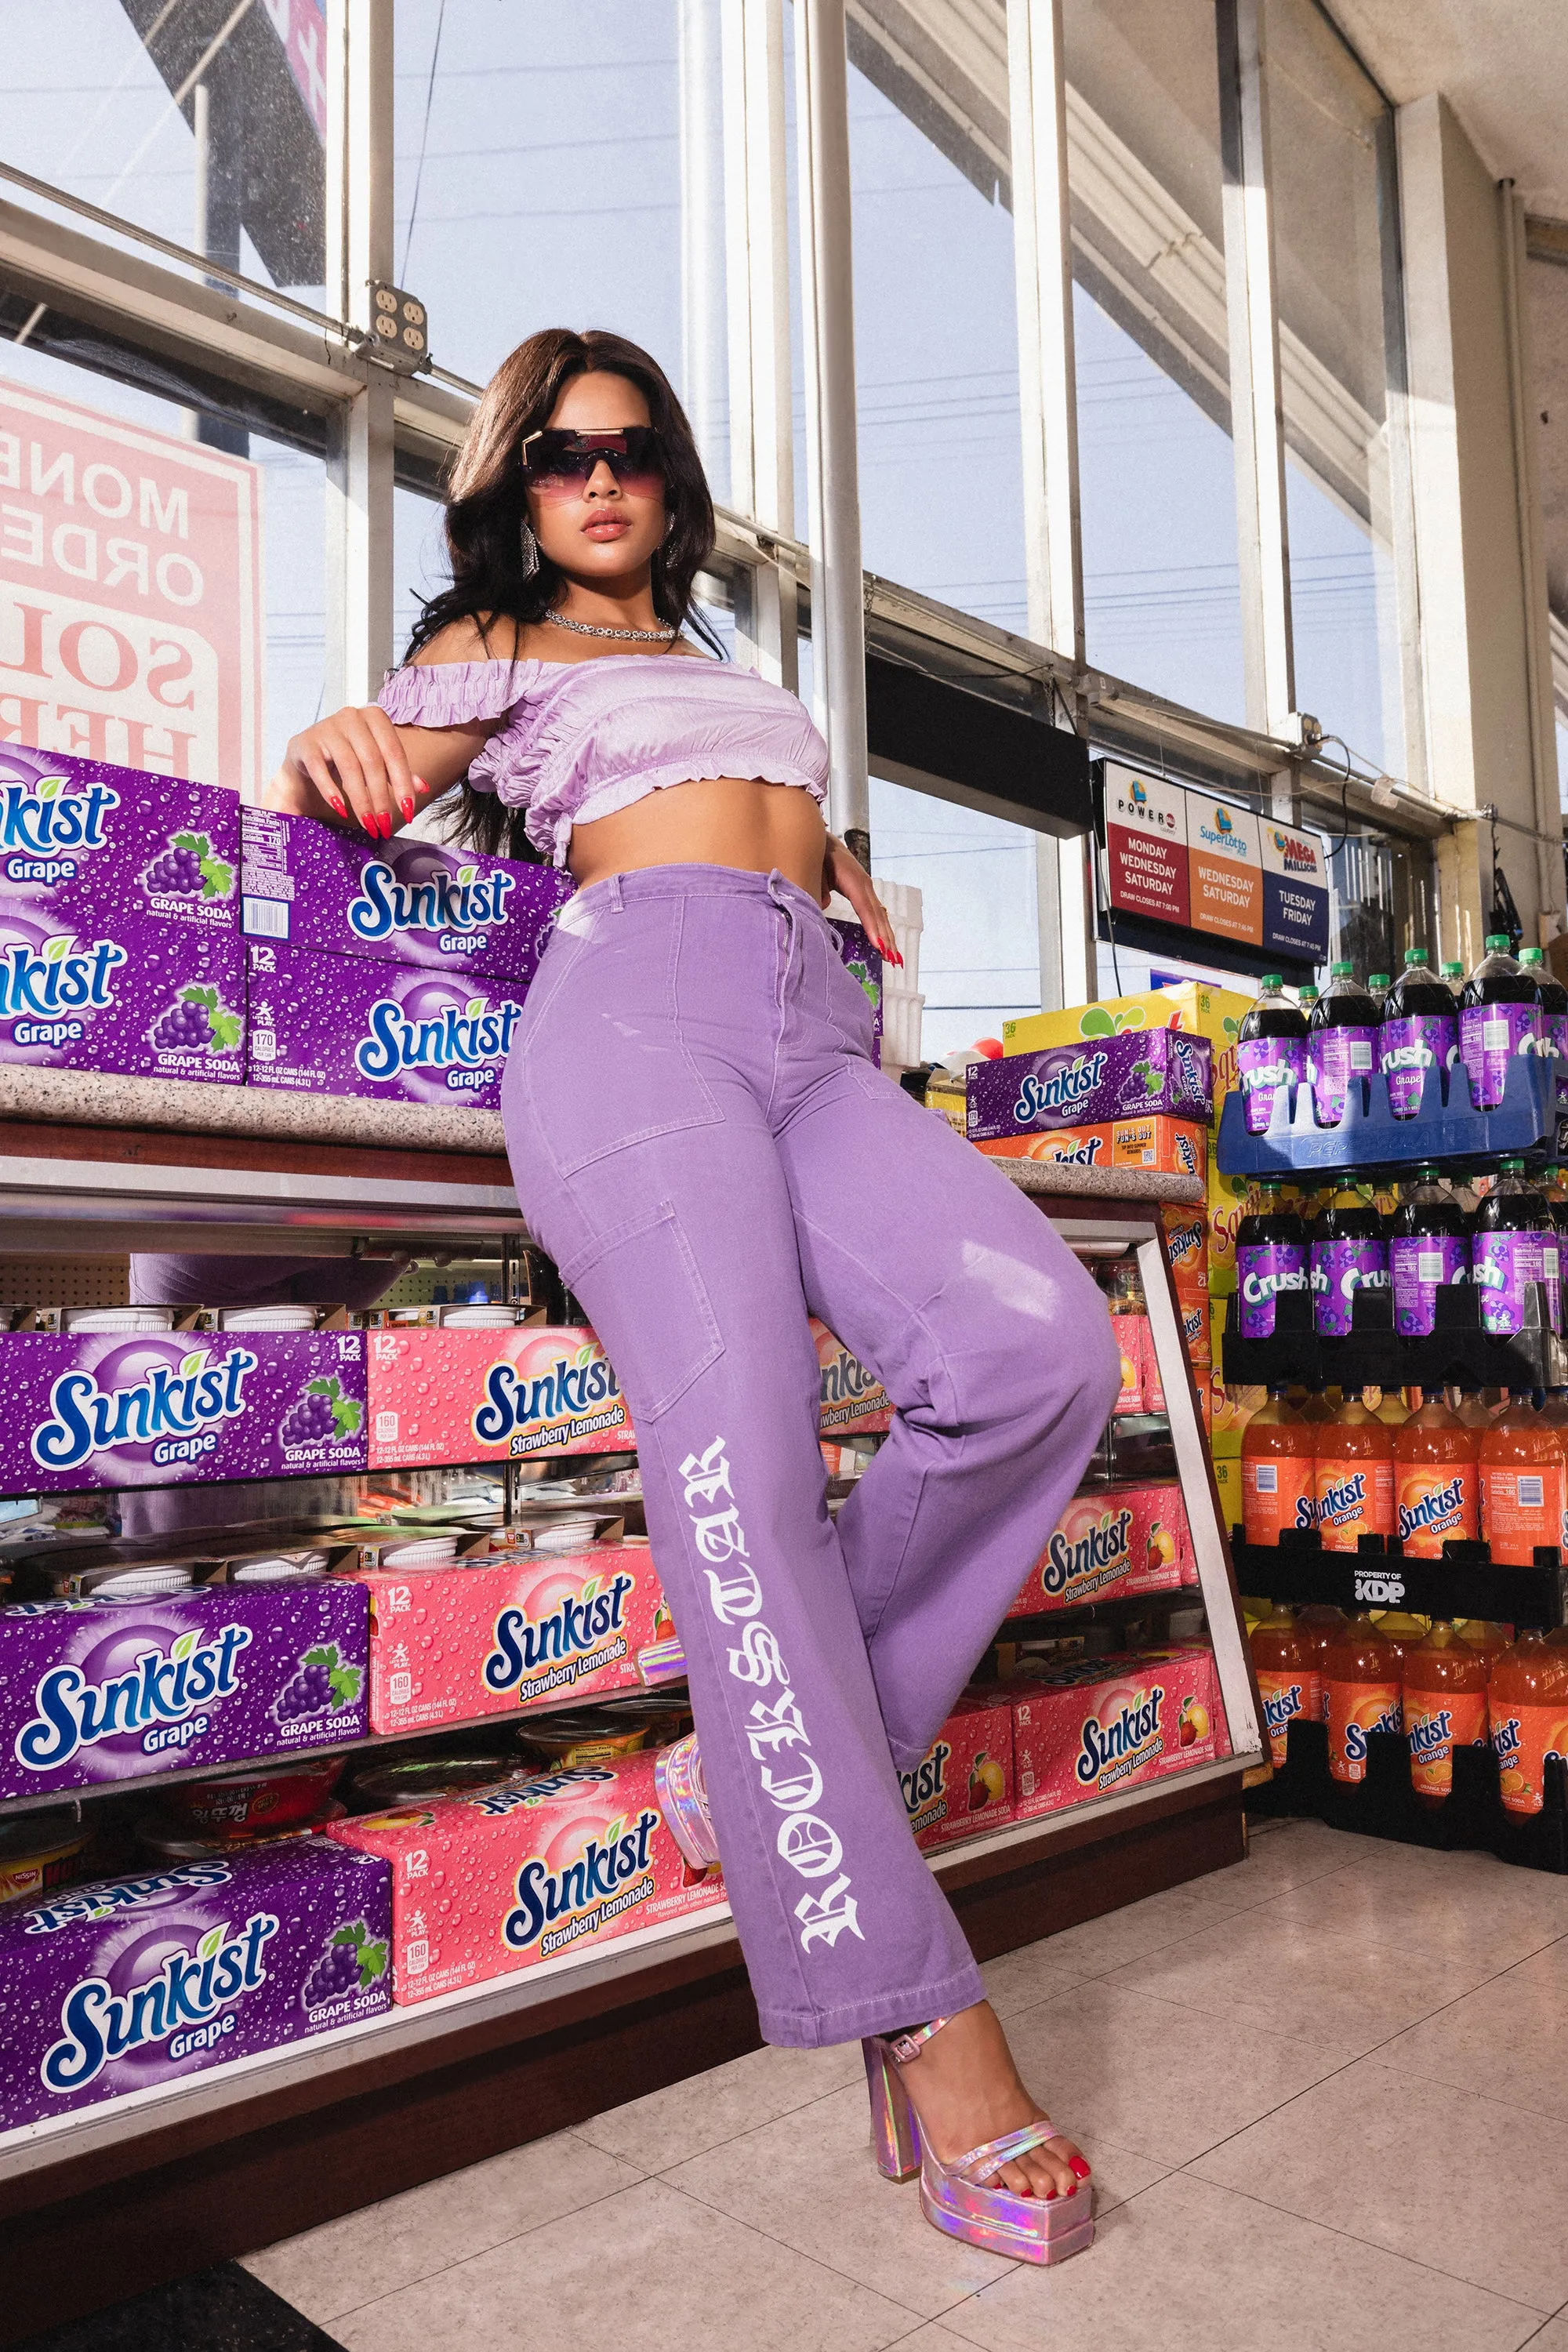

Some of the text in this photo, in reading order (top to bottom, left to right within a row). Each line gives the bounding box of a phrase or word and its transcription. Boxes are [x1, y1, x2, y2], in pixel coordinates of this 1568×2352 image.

[0, 785, 118, 853] kist
[1117, 799, 1165, 824] POWER
[1127, 837, 1167, 860] MONDAY
[1200, 826, 1247, 851] SuperLotto
[1283, 834, 1316, 865] MEGA
[9, 858, 75, 884] Grape
[1120, 851, 1177, 880] WEDNESDAY
[1283, 861, 1318, 873] MILLIONS
[1125, 871, 1174, 895] SATURDAY
[1198, 866, 1254, 893] WEDNESDAY
[350, 863, 513, 938] Sunkist
[1120, 891, 1135, 901] DRAW
[1136, 894, 1156, 907] CLOSES
[1172, 904, 1180, 913] PM
[1203, 884, 1250, 909] SATURDAY
[1279, 889, 1316, 912] TUESDAY
[150, 897, 232, 921] GRAPE SODA
[1283, 907, 1312, 926] FRIDAY
[1200, 913, 1214, 923] DRAW
[1214, 916, 1232, 927] CLOSES
[1232, 920, 1239, 929] AT
[440, 933, 488, 954] Grape
[1272, 931, 1285, 942] DRAW
[1285, 935, 1301, 947] CLOSES
[1315, 943, 1321, 952] PM
[250, 945, 275, 966] 12
[252, 964, 277, 974] PACK
[1200, 994, 1210, 1010] 36
[14, 1020, 82, 1046] Grape
[256, 1033, 274, 1046] 170
[358, 1002, 524, 1077] Sunkist
[1004, 1022, 1017, 1035] 36
[157, 1053, 241, 1073] GRAPE SODA
[967, 1065, 978, 1076] 12
[1176, 1040, 1205, 1105] Sunkist
[447, 1069, 495, 1089] Grape
[1015, 1054, 1106, 1121] Sunkist
[1181, 1075, 1190, 1097] Grape
[1396, 1073, 1421, 1086] Grape
[1062, 1099, 1089, 1116] Grape
[1122, 1099, 1163, 1111] GRAPE SODA
[1116, 1124, 1151, 1137] SUN'S OUT
[1116, 1131, 1152, 1144] FUN'S OUT
[1168, 1221, 1203, 1267] Sunkist
[1197, 1276, 1207, 1287] 12
[1243, 1265, 1309, 1304] Crush
[336, 1334, 361, 1355] 12
[373, 1334, 397, 1355] 12
[339, 1353, 361, 1362] PACK
[35, 1351, 253, 1466] Sunkist
[379, 1415, 396, 1427] 160
[510, 1425, 570, 1455] Strawberry
[570, 1405, 625, 1439] Lemonade
[154, 1434, 216, 1464] Grape
[285, 1446, 361, 1462] GRAPE SODA
[281, 1461, 305, 1470] natural
[312, 1458, 339, 1468] artificial
[339, 1457, 361, 1467] flavors
[1216, 1465, 1229, 1480] 36
[1333, 1506, 1363, 1526] Orange
[1398, 1477, 1463, 1541] Sunkist
[1431, 1512, 1462, 1534] Orange
[1044, 1511, 1131, 1593] Sunkist
[1065, 1577, 1098, 1602] Strawberry
[1098, 1559, 1131, 1587] Lemonade
[1354, 1570, 1402, 1581] PROPERTY OF
[387, 1585, 410, 1606] 12
[1358, 1580, 1406, 1604] KDP
[390, 1604, 412, 1613] PACK
[485, 1575, 632, 1689] Sunkist
[521, 1668, 576, 1700] Strawberry
[577, 1639, 627, 1675] Lemonade
[392, 1675, 409, 1689] 160
[20, 1627, 249, 1766] Sunkist
[677, 1434, 866, 1955] ROCKSTAR
[1017, 1704, 1031, 1721] 12
[143, 1716, 208, 1752] Grape
[276, 1735, 301, 1747] natural
[309, 1730, 336, 1741] artificial
[337, 1726, 361, 1737] flavors
[281, 1715, 360, 1738] GRAPE SODA
[1076, 1688, 1163, 1782] Sunkist
[1098, 1763, 1133, 1789] Strawberry
[1132, 1736, 1163, 1771] Lemonade
[1159, 1752, 1183, 1766] STRAWBERRY
[1182, 1747, 1204, 1760] LEMONADE
[1203, 1744, 1214, 1755] SODA
[1418, 1745, 1450, 1764] Orange
[472, 1764, 616, 1816] Sunkist
[1022, 1775, 1034, 1784] 160
[910, 1800, 948, 1833] emonade
[941, 1815, 972, 1834] STRAWBERRY
[971, 1809, 998, 1824] LEMONADE
[997, 1804, 1011, 1817] SODA
[404, 1849, 428, 1873] 12
[15, 1871, 37, 1882] NISSIN
[406, 1868, 429, 1881] PACK
[506, 1813, 657, 1946] Sunkist
[26, 1860, 231, 1933] Sunkist
[645, 1883, 719, 1915] STRAWBERRY LEMONADE
[541, 1878, 654, 1956] Strawberry Lemonade
[410, 1928, 426, 1938] PLAY
[408, 1956, 428, 1967] CALORIES
[409, 1943, 426, 1959] 160
[406, 1977, 423, 1990] 12-12
[422, 1975, 430, 1985] FL
[428, 1973, 436, 1984] OZ
[435, 1969, 450, 1981] CANS
[449, 1965, 460, 1977] (144
[459, 1963, 467, 1974] FL
[45, 1917, 276, 2087] Sunkist
[308, 1992, 387, 2024] GRAPE SODA
[304, 2020, 328, 2033] natural
[336, 2012, 365, 2024] artificial
[365, 2003, 387, 2017] flavors
[170, 2015, 235, 2058] Grape
